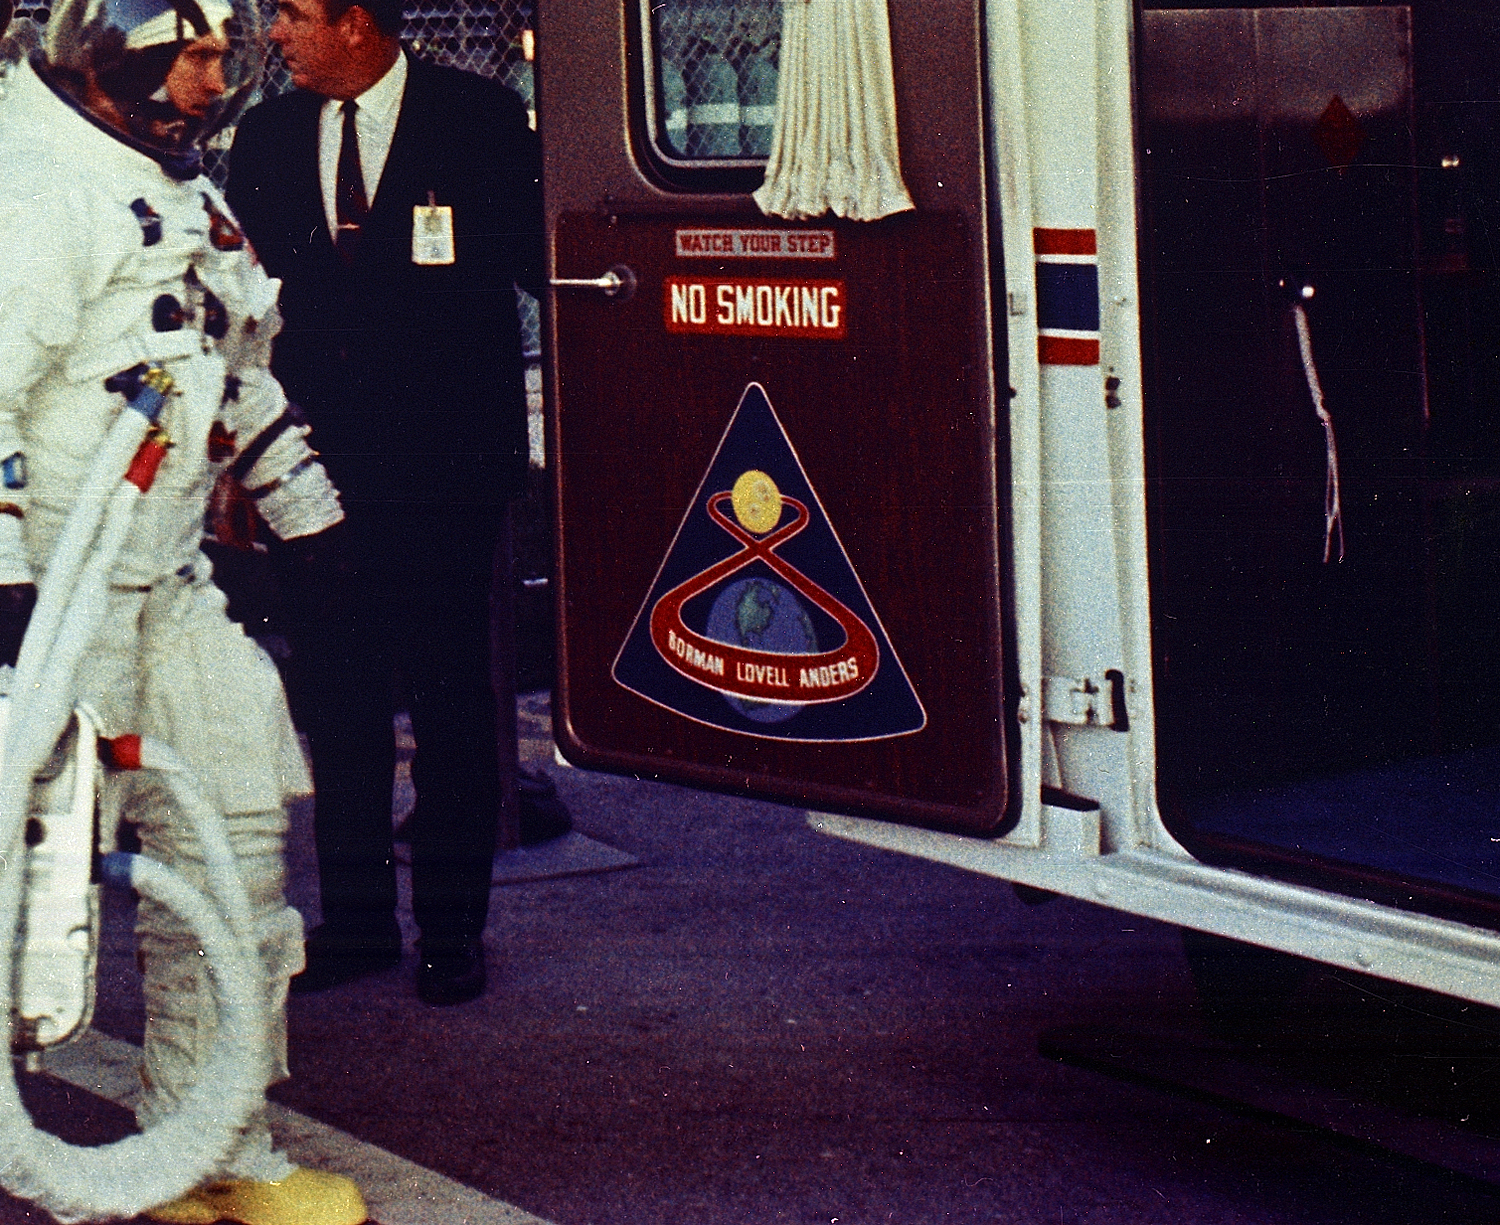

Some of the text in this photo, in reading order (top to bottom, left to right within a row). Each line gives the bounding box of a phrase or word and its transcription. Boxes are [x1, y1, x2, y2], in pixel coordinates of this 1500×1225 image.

[679, 234, 831, 253] WATCH YOUR STEP
[671, 284, 841, 328] NO SMOKING
[668, 629, 859, 689] BORMAN LOVELL ANDERS
